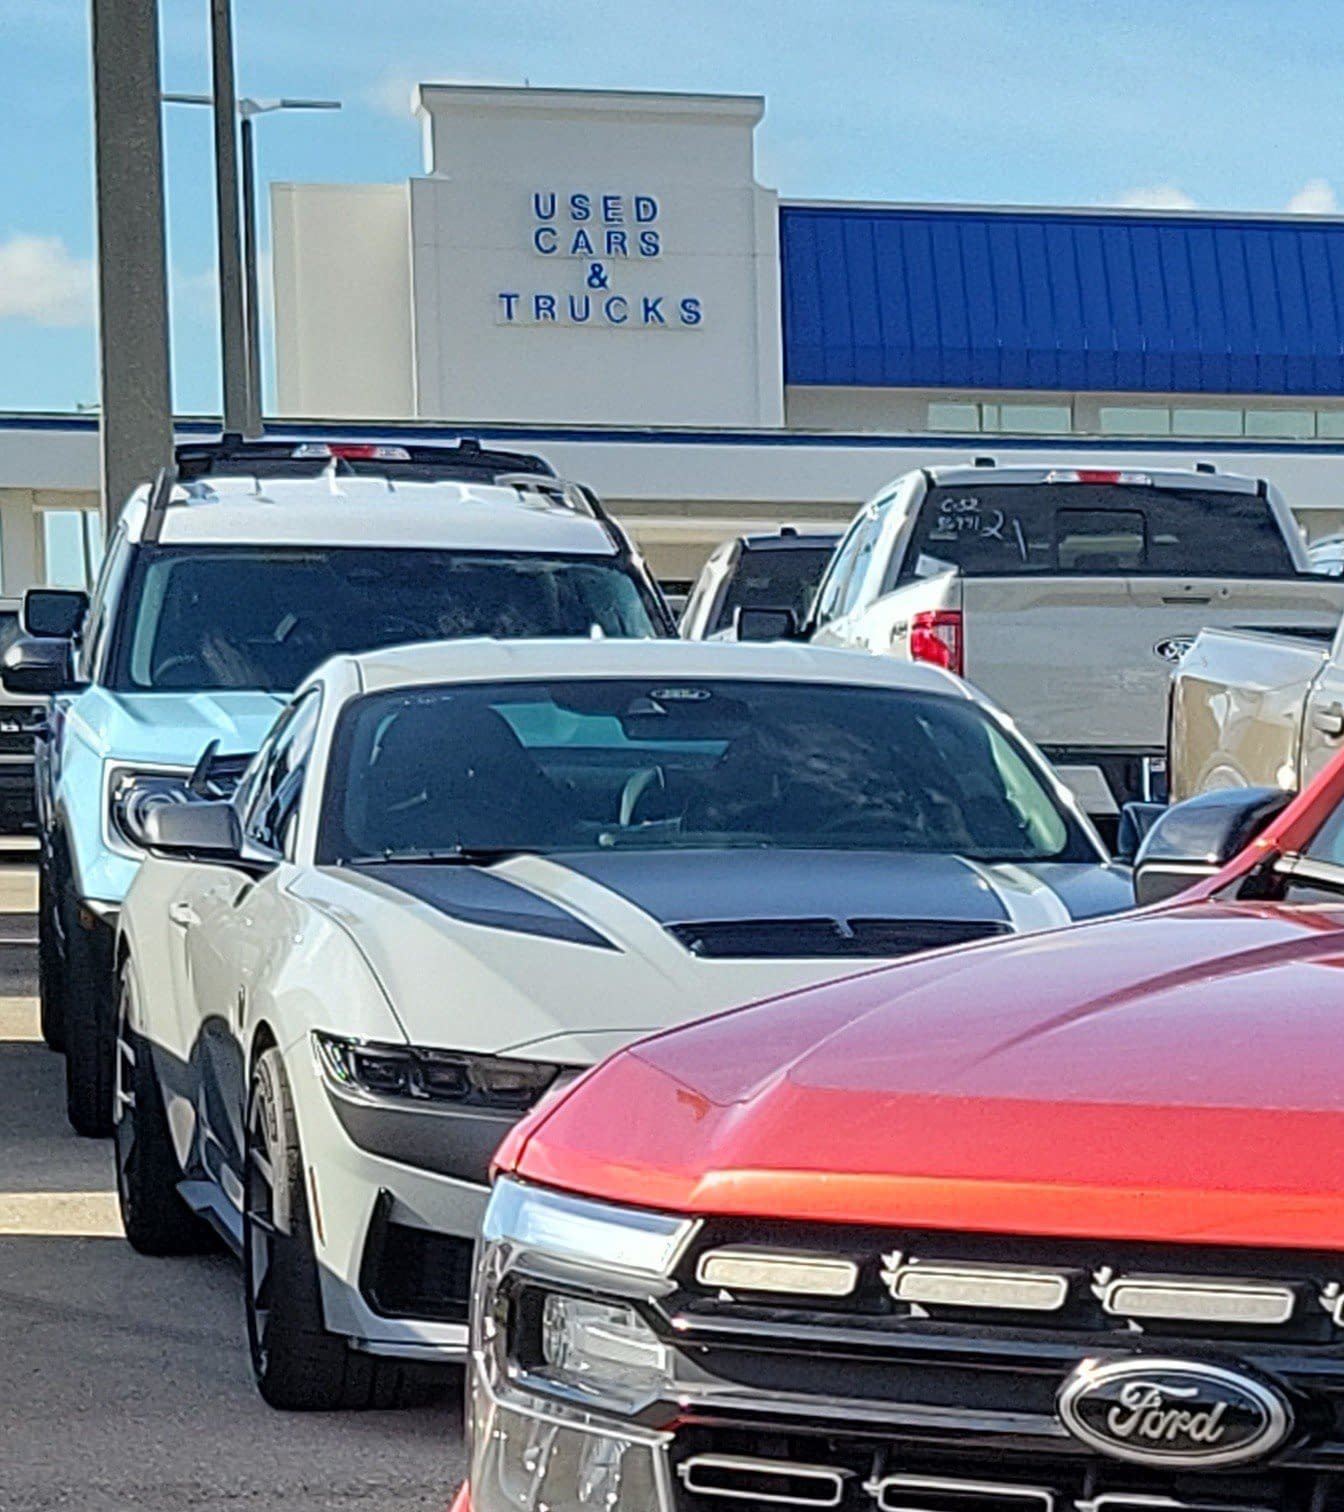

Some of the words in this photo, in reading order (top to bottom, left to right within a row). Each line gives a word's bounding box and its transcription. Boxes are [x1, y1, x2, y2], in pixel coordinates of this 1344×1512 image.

[534, 193, 658, 222] USED
[534, 227, 660, 257] CARS
[587, 262, 609, 289] &
[499, 293, 702, 325] TRUCKS
[1107, 1381, 1227, 1443] Ford
